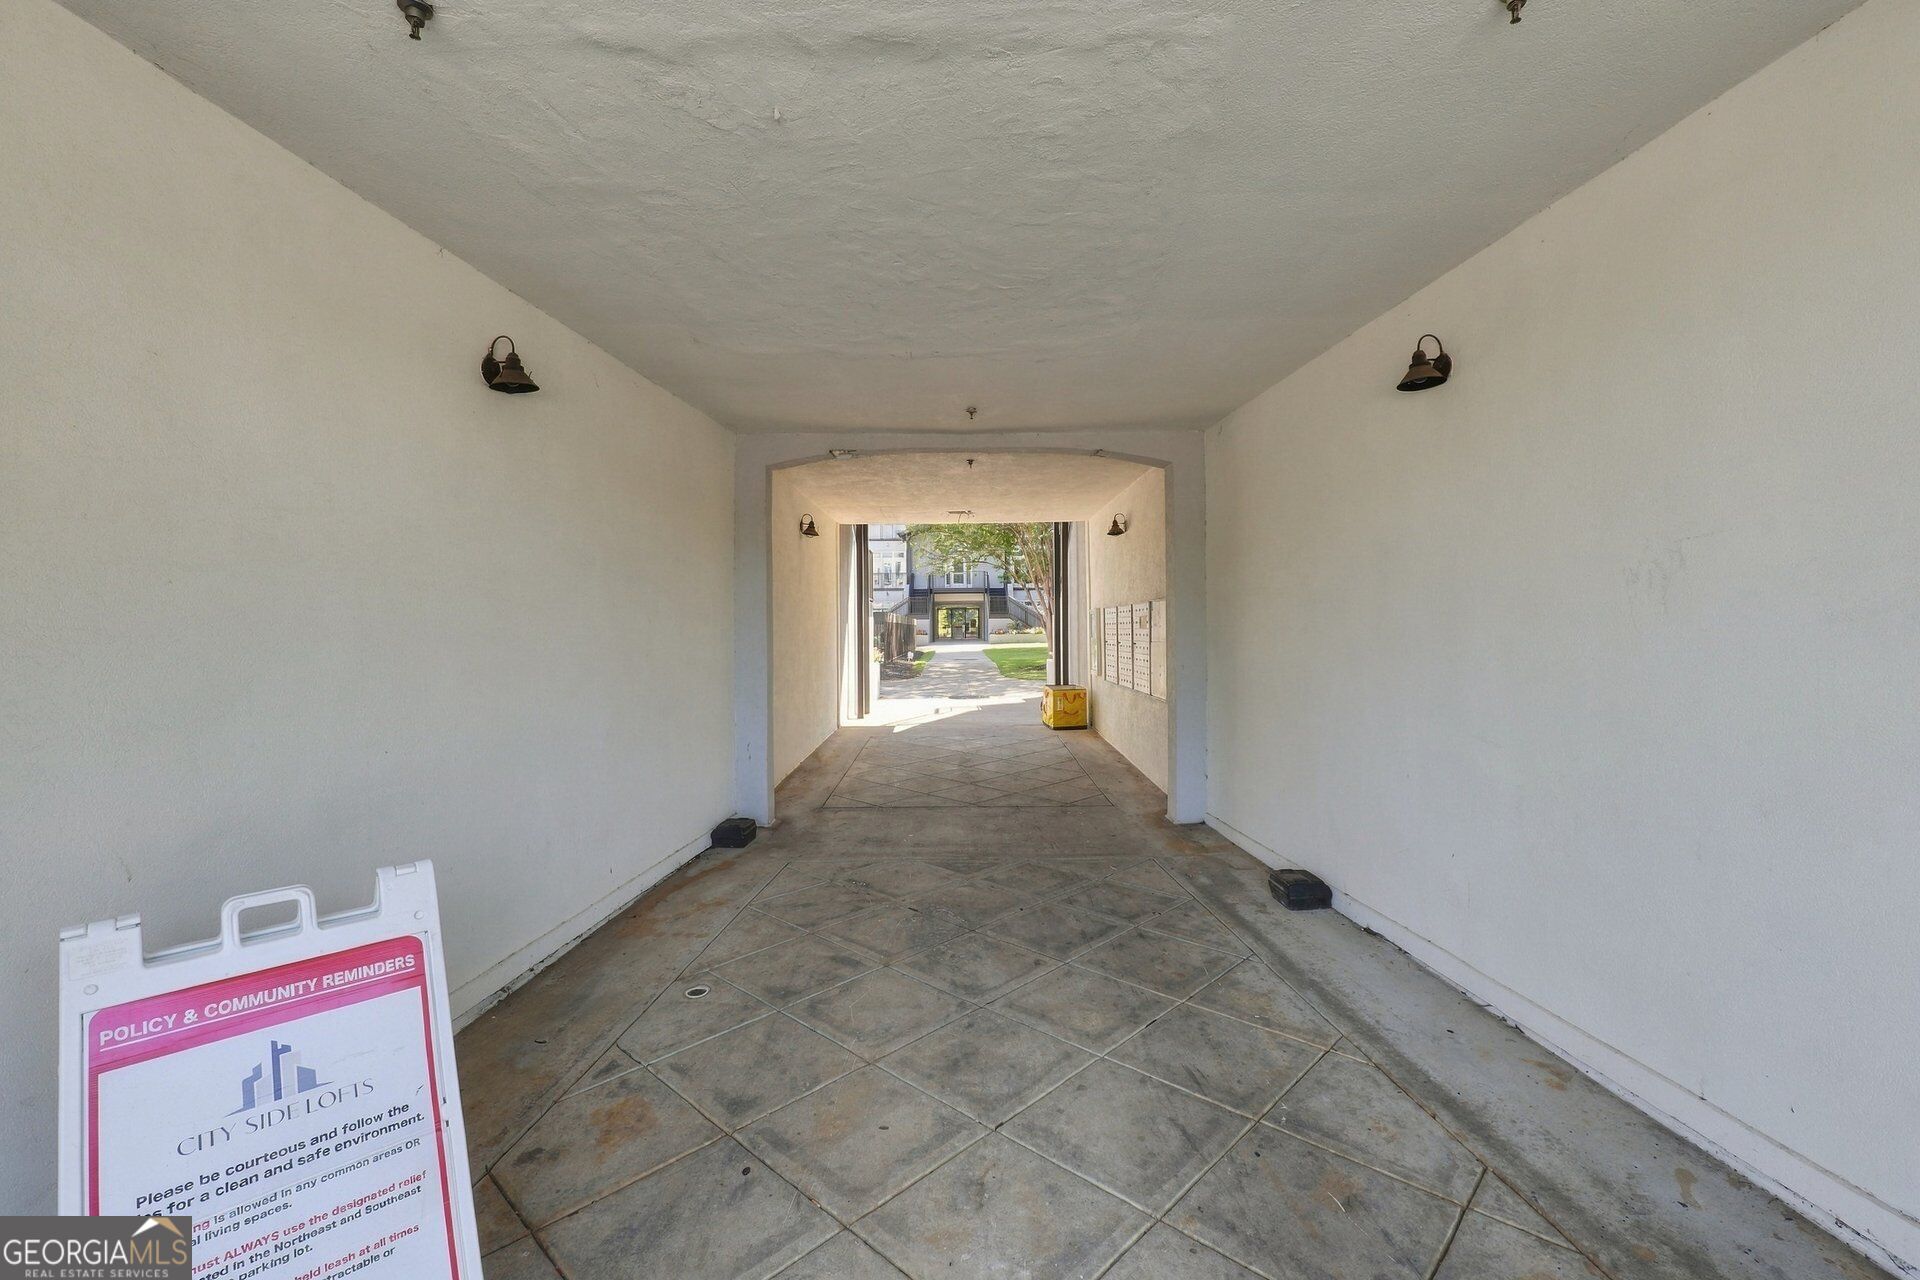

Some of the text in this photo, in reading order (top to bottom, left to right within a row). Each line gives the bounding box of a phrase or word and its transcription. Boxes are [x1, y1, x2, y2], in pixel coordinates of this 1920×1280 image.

[100, 954, 415, 1046] POLICY & COMMUNITY REMINDERS
[136, 1103, 410, 1209] Please be courteous and follow the
[177, 1078, 374, 1156] CITY SIDE LOFTS
[167, 1112, 425, 1214] for a clean and safe environment.
[214, 1215, 225, 1224] is
[229, 1192, 278, 1219] allowed
[281, 1188, 292, 1199] in
[295, 1179, 318, 1193] any
[320, 1157, 370, 1183] common
[372, 1146, 403, 1163] areas
[405, 1137, 421, 1150] OR
[205, 1221, 240, 1241] living
[243, 1202, 293, 1226] spaces.
[223, 1231, 280, 1262] ALWAYS
[283, 1221, 306, 1237] use
[308, 1212, 329, 1226] the
[332, 1183, 396, 1216] designated
[398, 1169, 427, 1189] relief
[233, 1260, 245, 1271] in
[248, 1249, 271, 1264] the
[274, 1220, 338, 1253] Northeast
[340, 1209, 362, 1225] and
[364, 1185, 422, 1215] Southeast
[324, 1253, 355, 1272] leash
[359, 1245, 371, 1257] at
[373, 1237, 386, 1250] all
[389, 1224, 420, 1242] times
[383, 1247, 396, 1258] or
[239, 1244, 313, 1280] parking lot.
